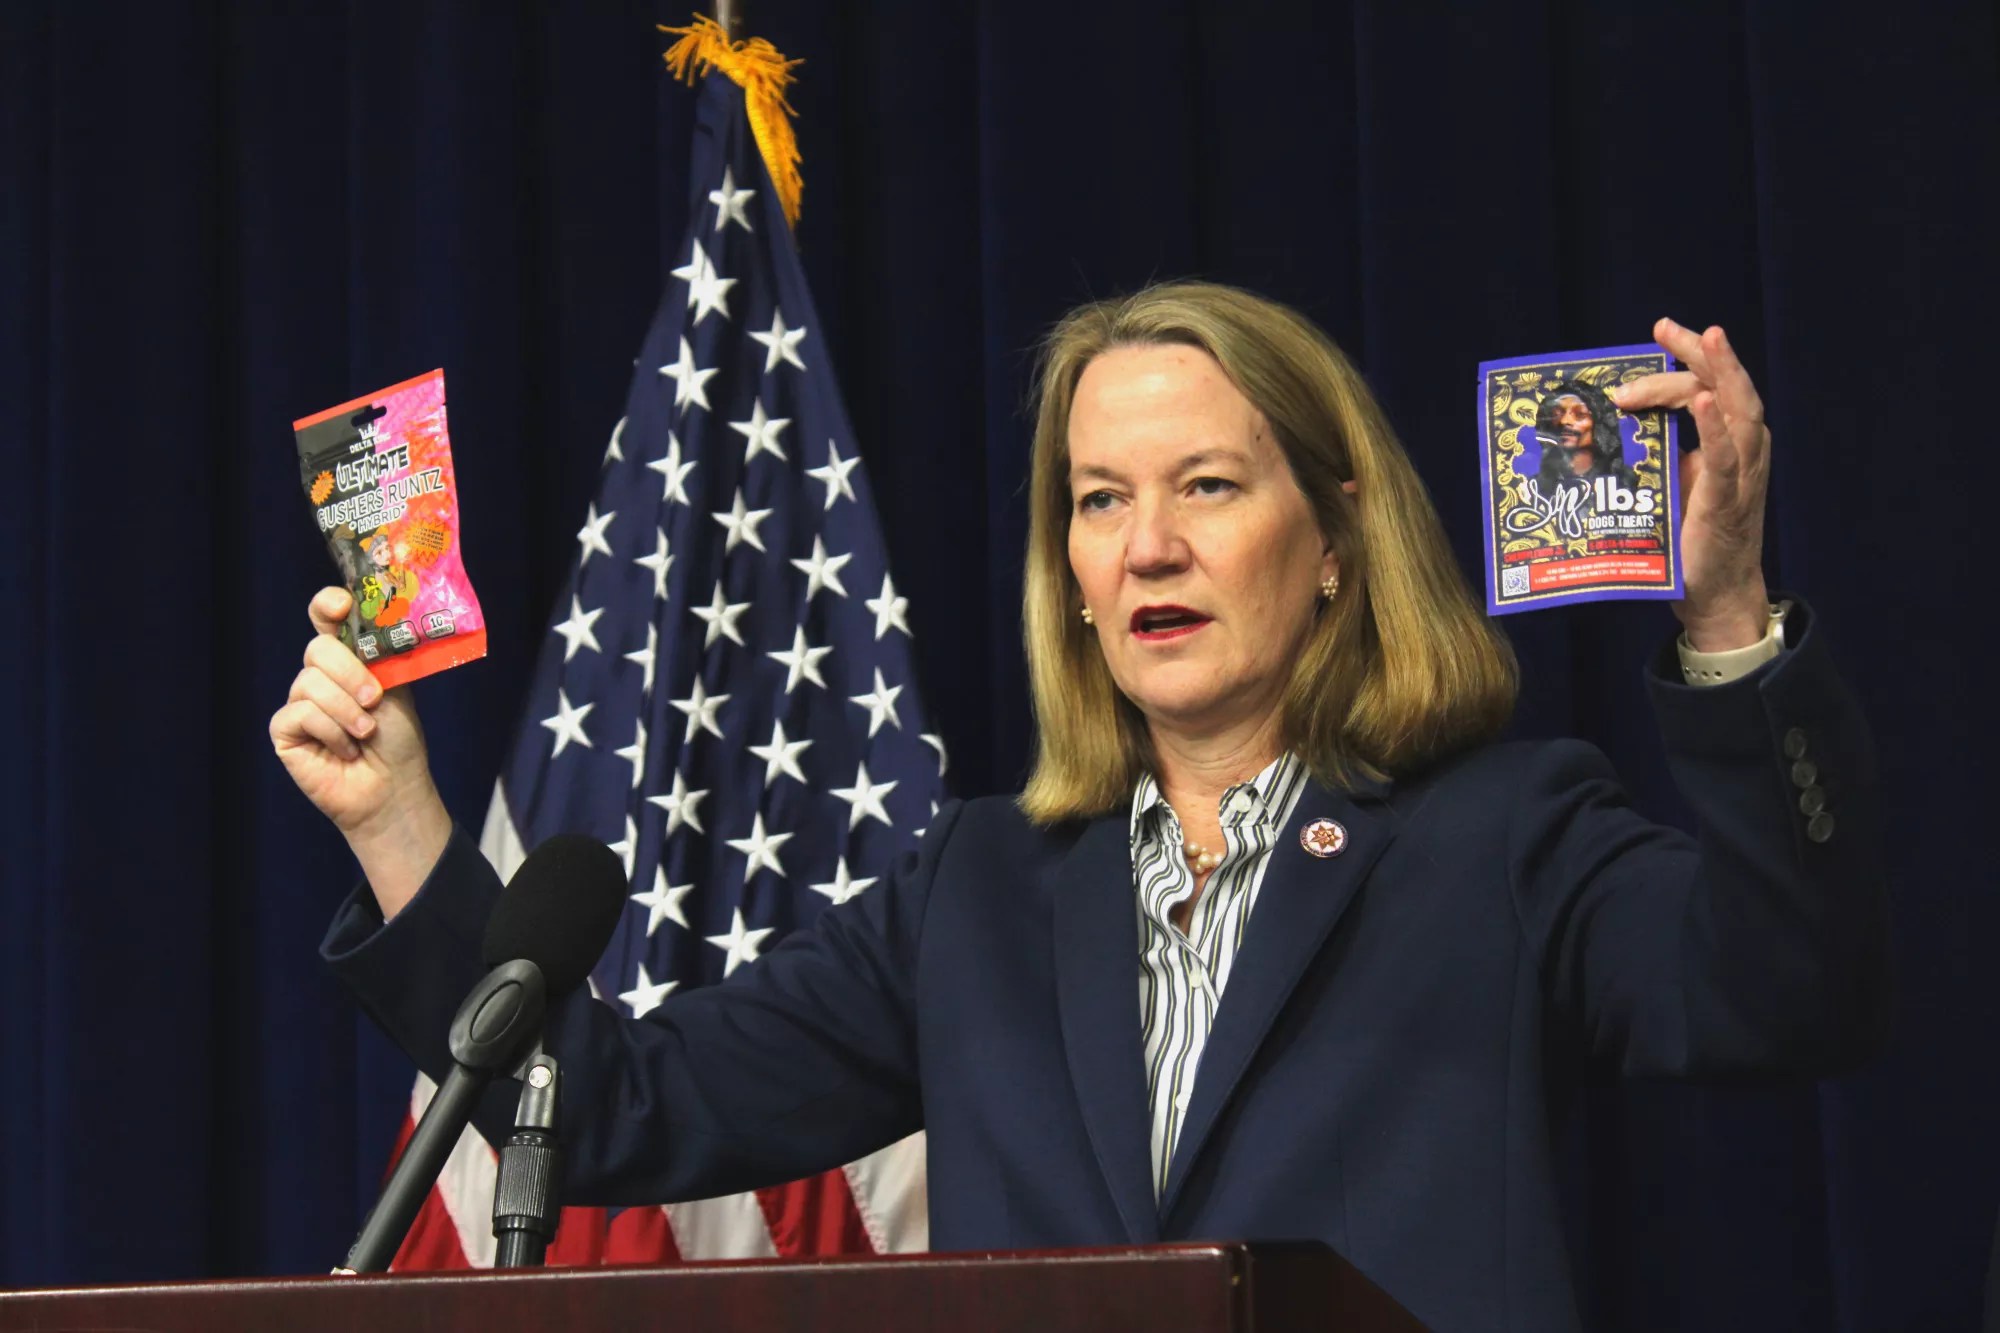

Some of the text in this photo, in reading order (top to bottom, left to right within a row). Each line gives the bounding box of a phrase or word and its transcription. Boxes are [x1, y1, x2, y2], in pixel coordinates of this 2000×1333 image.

[349, 439, 374, 454] DELTA
[336, 442, 409, 492] ULTIMATE
[317, 467, 444, 532] GUSHERS RUNTZ
[1594, 476, 1655, 513] lbs
[358, 506, 402, 534] HYBRID
[1588, 514, 1655, 530] DOGG TREATS
